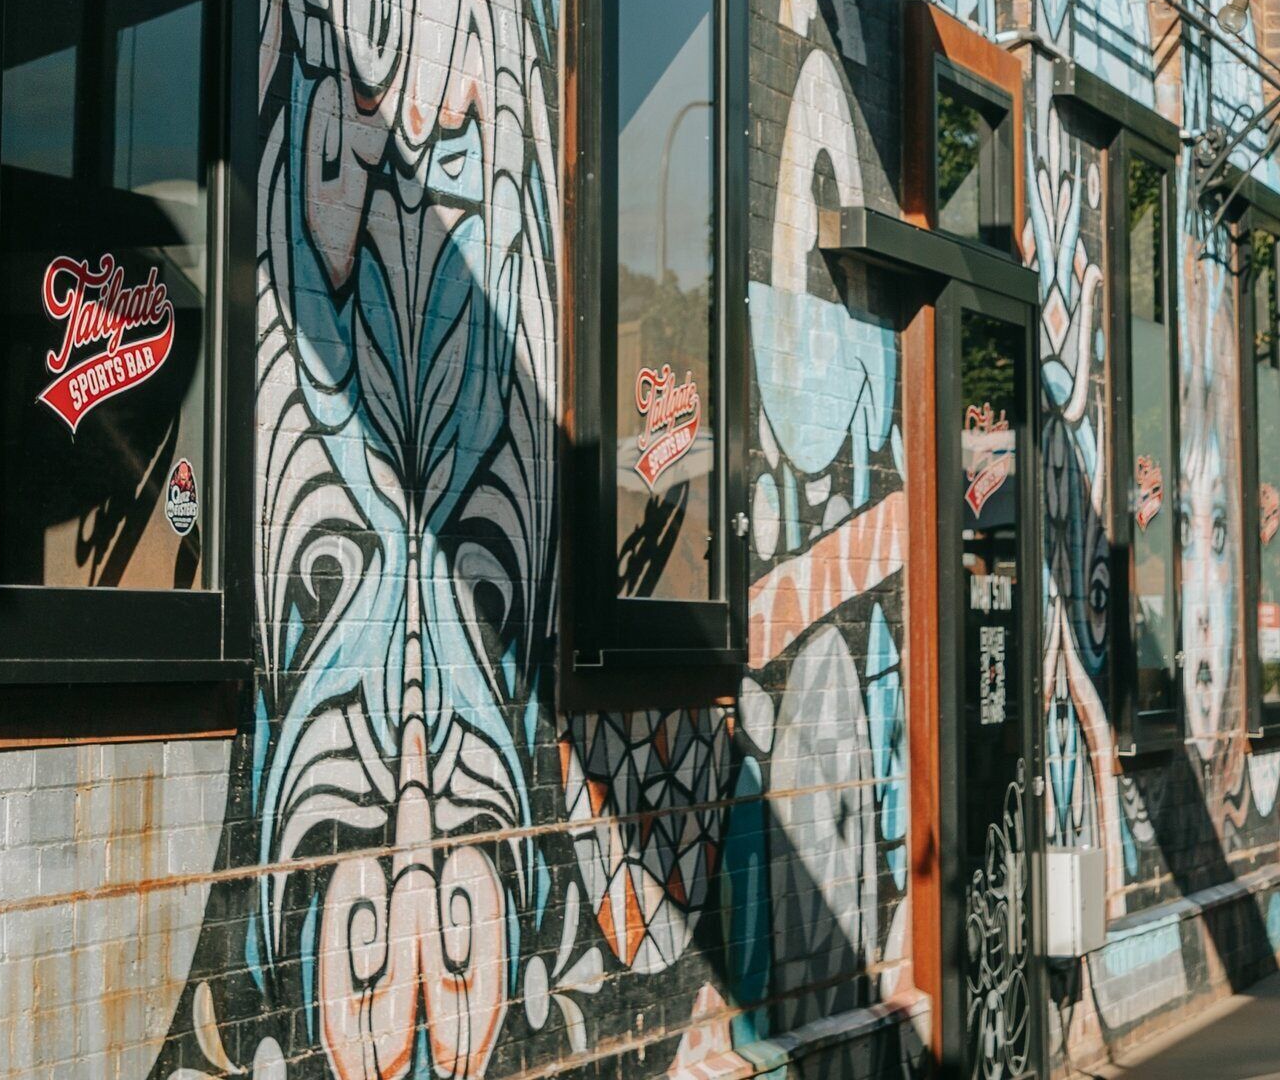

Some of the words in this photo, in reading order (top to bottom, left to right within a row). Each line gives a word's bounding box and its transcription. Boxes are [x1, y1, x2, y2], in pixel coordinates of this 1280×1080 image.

[42, 253, 166, 374] Tailgate
[69, 356, 124, 411] SPORTS
[125, 346, 155, 377] BAR
[636, 363, 696, 451] Tailgate
